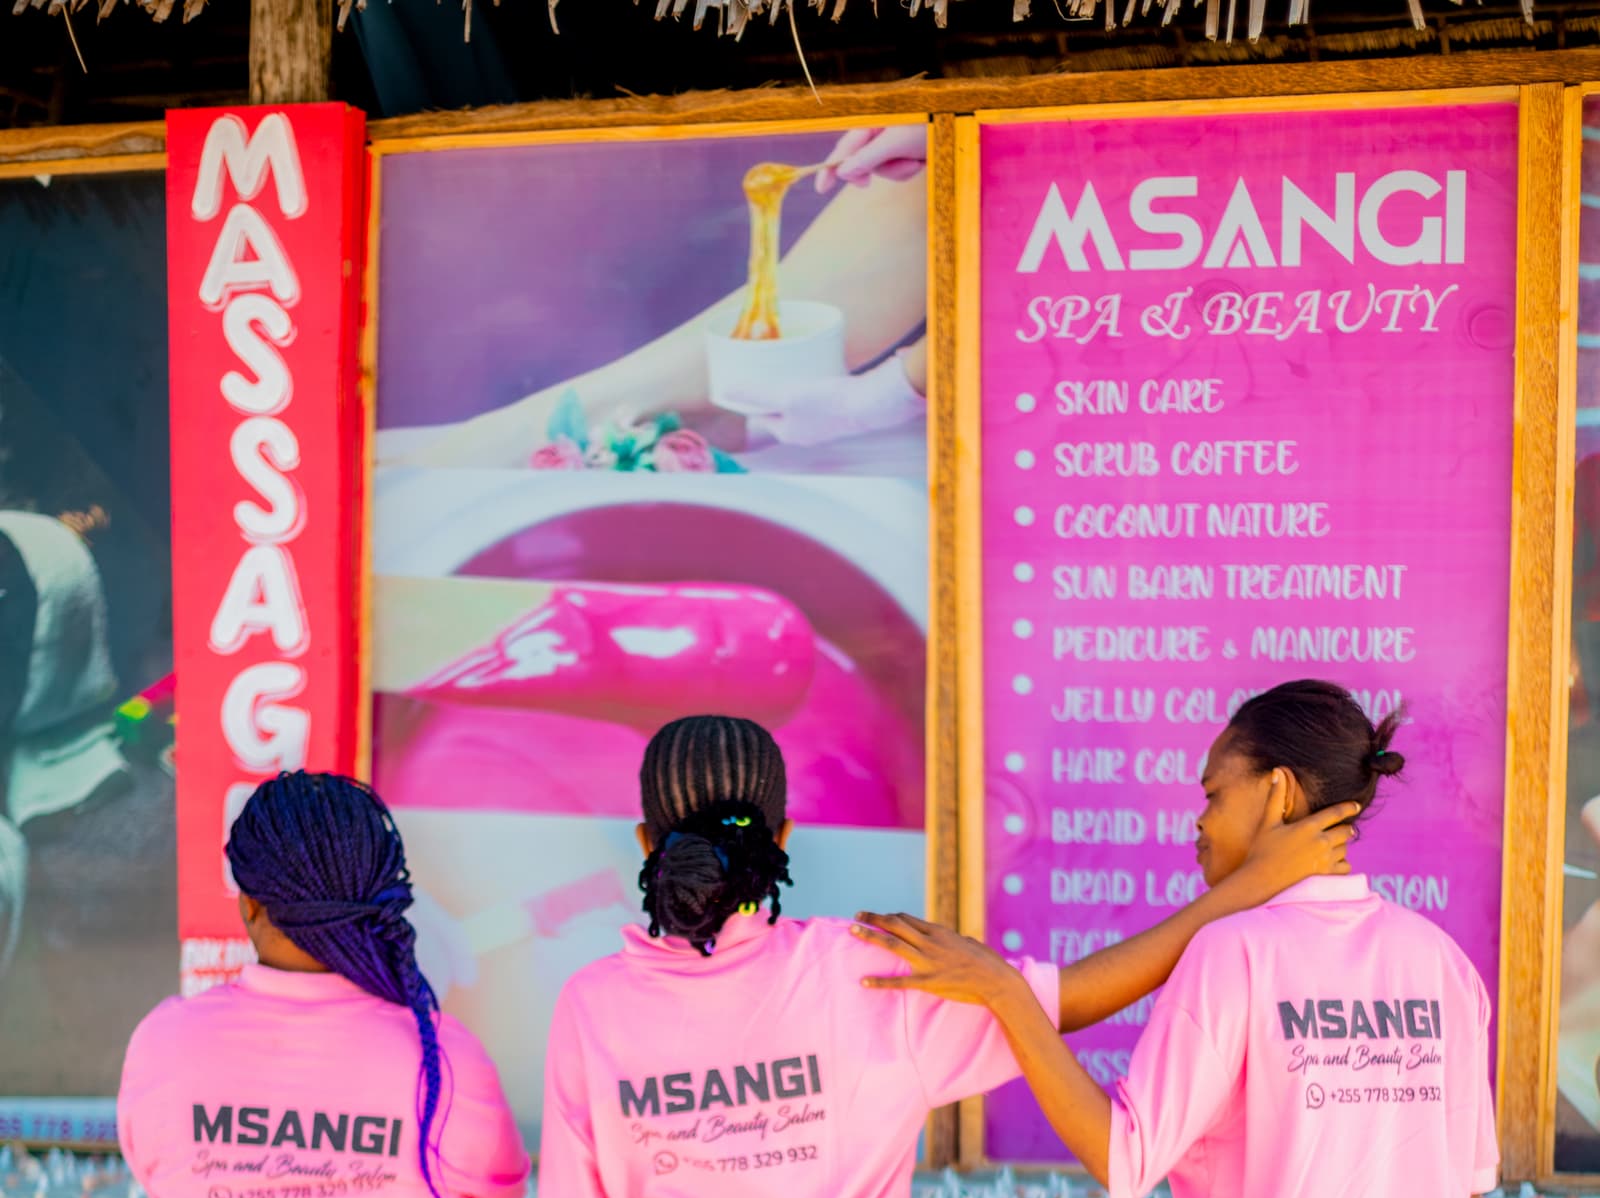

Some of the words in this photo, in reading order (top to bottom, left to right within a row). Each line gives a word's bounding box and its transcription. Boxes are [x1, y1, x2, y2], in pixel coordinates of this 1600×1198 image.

[1015, 170, 1467, 273] MSANGI
[1016, 294, 1124, 345] SPA
[1140, 286, 1194, 341] &
[1203, 283, 1459, 341] BEAUTY
[1054, 380, 1129, 415] SKIN
[1138, 379, 1225, 414] CARE
[1053, 441, 1161, 477] SCRUB
[1170, 440, 1300, 476] COFFEE
[192, 112, 309, 898] MASSAG
[1053, 503, 1203, 539] COCONUT
[1206, 502, 1331, 538] NATURE
[1052, 564, 1117, 600] SUN
[1127, 564, 1214, 600] BARN
[1221, 563, 1408, 600] TREATMENT
[1052, 625, 1212, 662] PEDICURE
[1221, 638, 1239, 660] &
[1250, 626, 1416, 663] MANICURE
[1051, 687, 1155, 724] JELLY
[1164, 687, 1270, 724] COLO
[1052, 747, 1126, 784] HAIR
[1051, 808, 1146, 845] BRAID
[1156, 809, 1201, 846] HA
[1145, 869, 1206, 907] LOC
[1277, 998, 1442, 1041] MSANGI
[1287, 1044, 1319, 1075] Spa
[1322, 1045, 1351, 1066] and
[1352, 1044, 1403, 1076] Beauty
[618, 1054, 823, 1118] MSANGI
[1330, 1087, 1361, 1104] +255
[1364, 1087, 1390, 1102] 778
[1392, 1086, 1415, 1103] 329
[192, 1103, 403, 1157] MSANGI
[666, 1118, 700, 1142] and
[702, 1112, 769, 1144] Beauty
[772, 1103, 826, 1133] Salon
[192, 1148, 228, 1178] Spa
[233, 1154, 269, 1174] and
[266, 1153, 338, 1180] Beauty
[718, 1156, 749, 1172] 778
[753, 1151, 784, 1169] 329
[787, 1145, 819, 1163] 932
